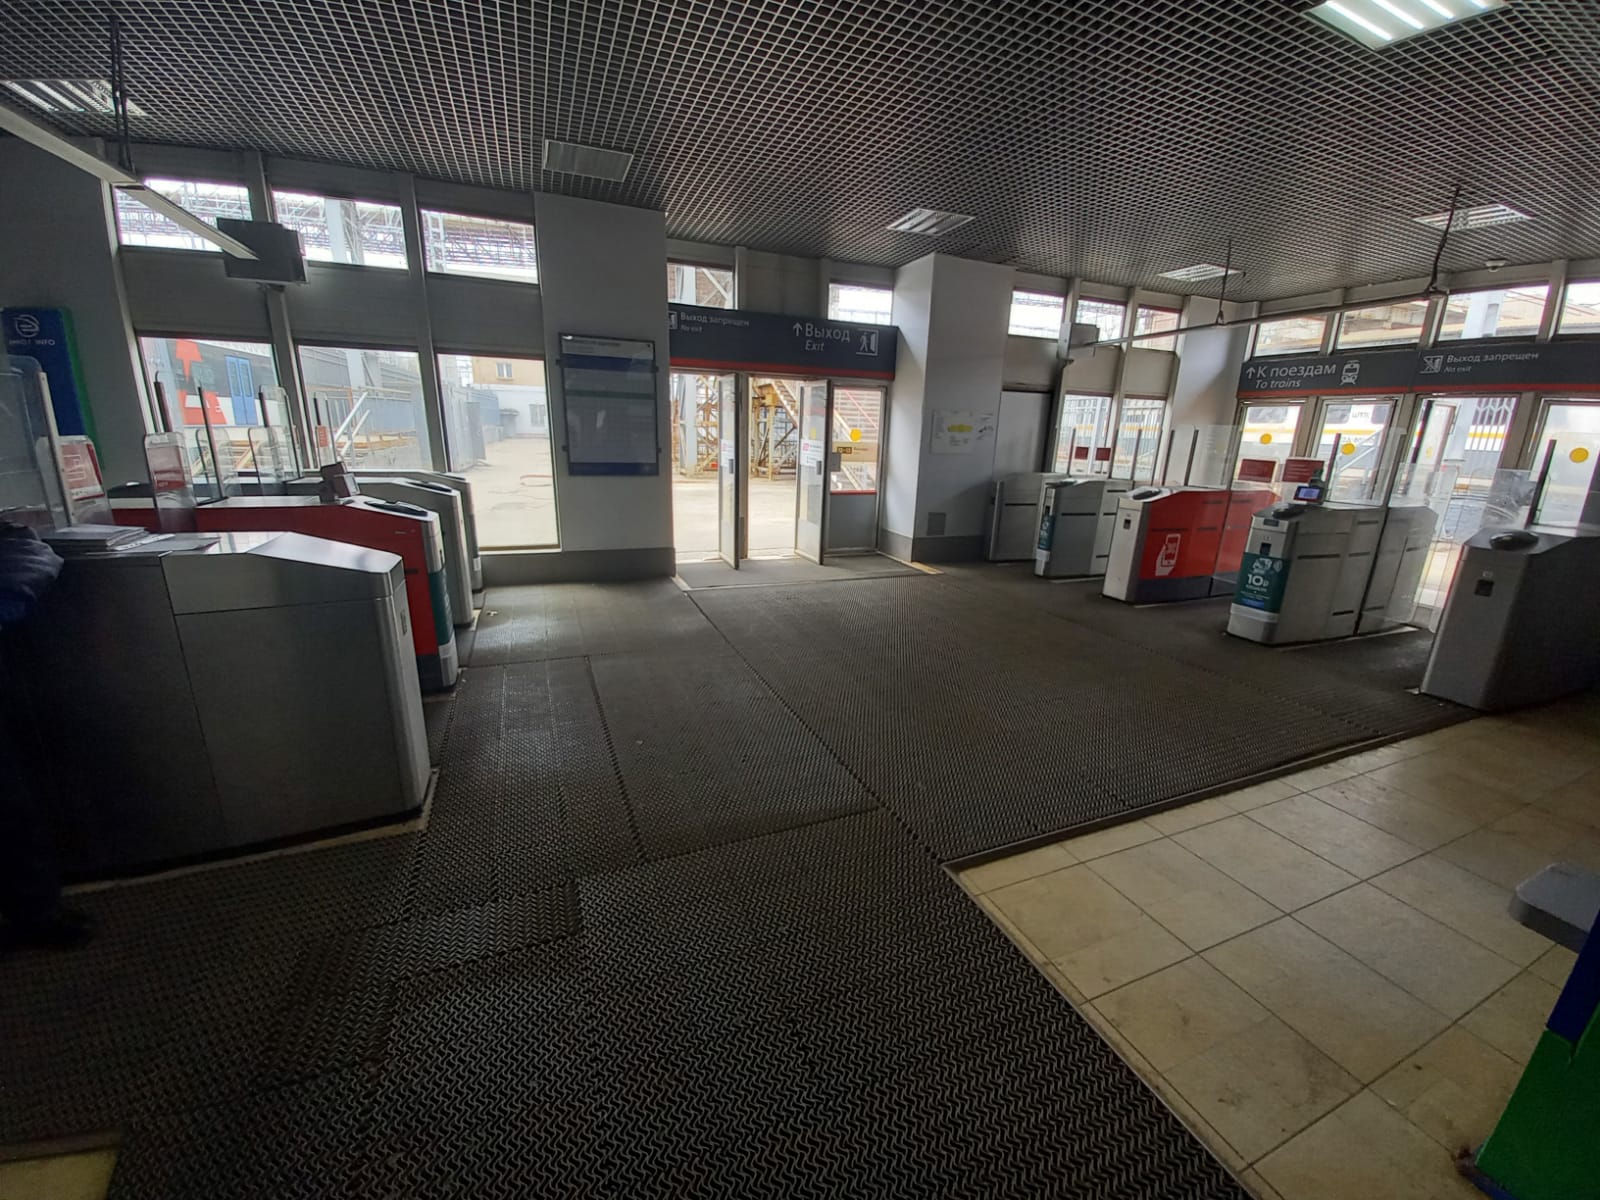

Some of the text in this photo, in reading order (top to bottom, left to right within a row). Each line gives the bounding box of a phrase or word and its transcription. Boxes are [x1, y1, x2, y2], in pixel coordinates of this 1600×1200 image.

[680, 311, 707, 323] Выход
[805, 322, 850, 343] Выход
[805, 339, 825, 351] Exit
[1446, 351, 1540, 364] Выход запрещен
[1257, 363, 1337, 379] К поездам
[1255, 378, 1301, 389] To trains
